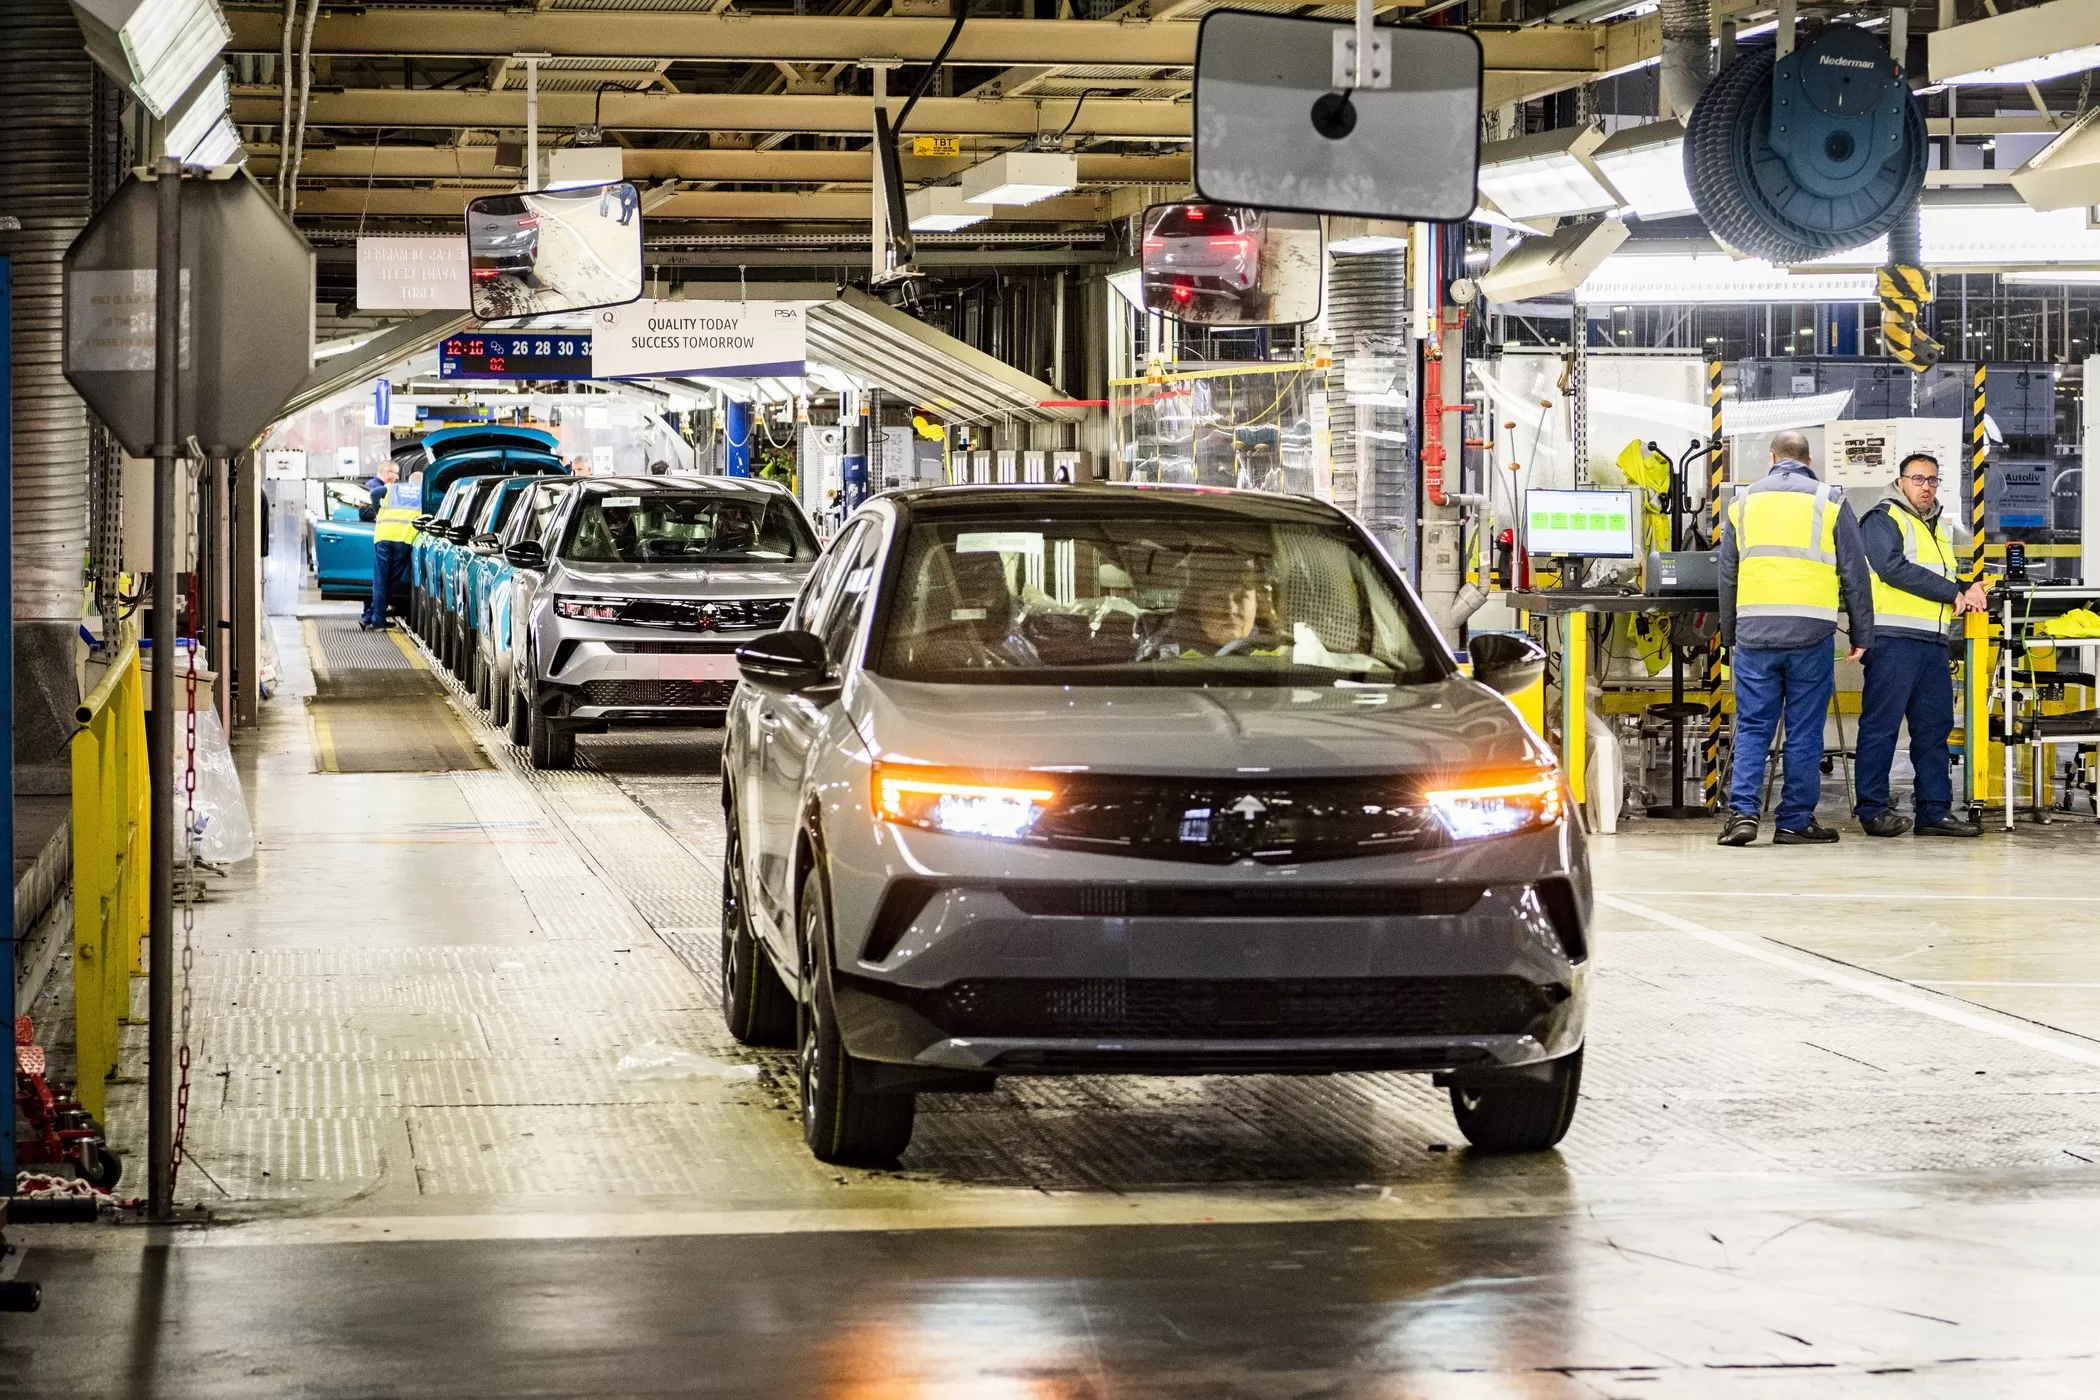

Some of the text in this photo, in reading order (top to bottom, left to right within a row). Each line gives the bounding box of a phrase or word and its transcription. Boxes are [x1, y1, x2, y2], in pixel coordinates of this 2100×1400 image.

[1819, 55, 1874, 68] Nederman
[933, 138, 953, 146] TBT
[602, 311, 614, 323] Q
[774, 309, 798, 318] PSA
[648, 318, 739, 331] QUALITY TODAY
[512, 340, 528, 355] 26
[535, 340, 551, 355] 28
[557, 341, 574, 356] 30
[631, 336, 755, 349] SUCCESS TOMORROW
[2005, 473, 2040, 481] Autoliv
